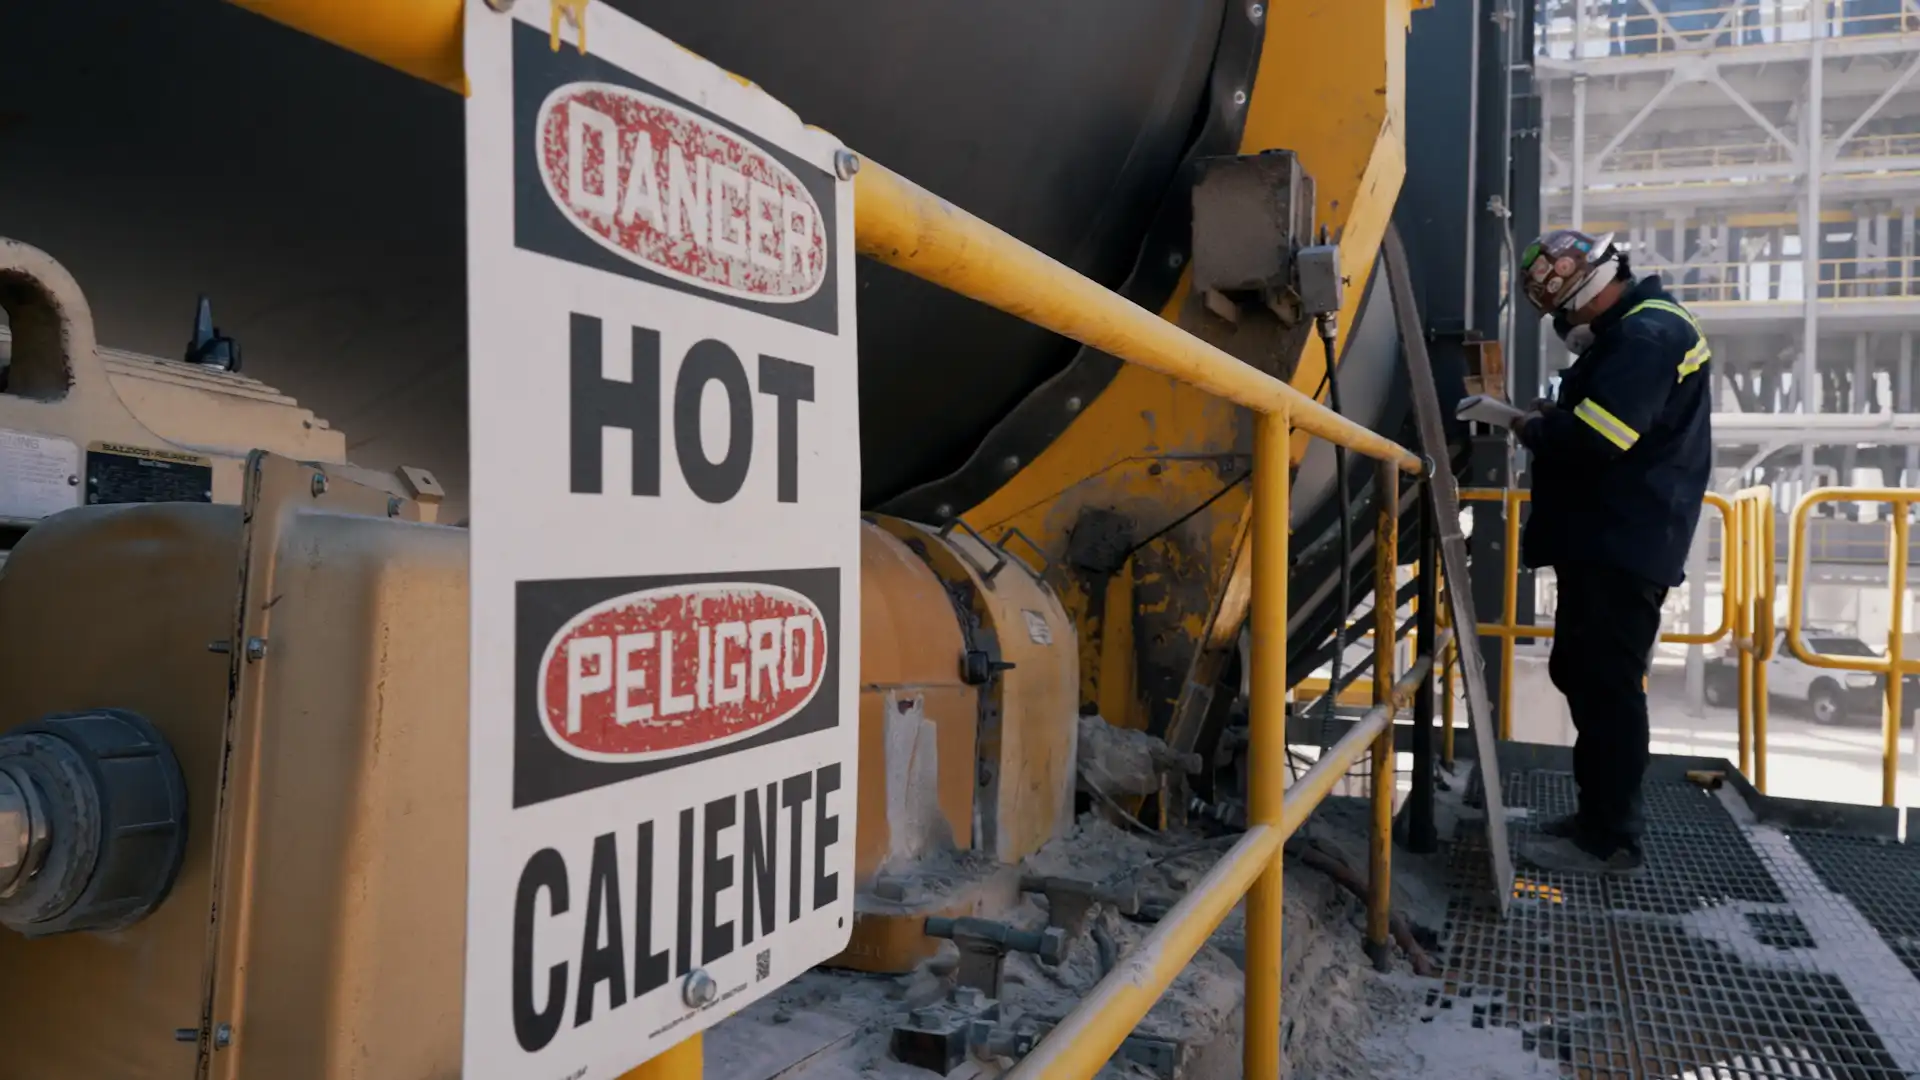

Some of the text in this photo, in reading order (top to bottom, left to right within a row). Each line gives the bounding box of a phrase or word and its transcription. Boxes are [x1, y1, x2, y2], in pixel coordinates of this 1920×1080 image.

[568, 100, 814, 282] DANGER
[570, 311, 814, 503] HOT
[565, 614, 814, 736] PELIGRO
[512, 762, 841, 1053] CALIENTE
